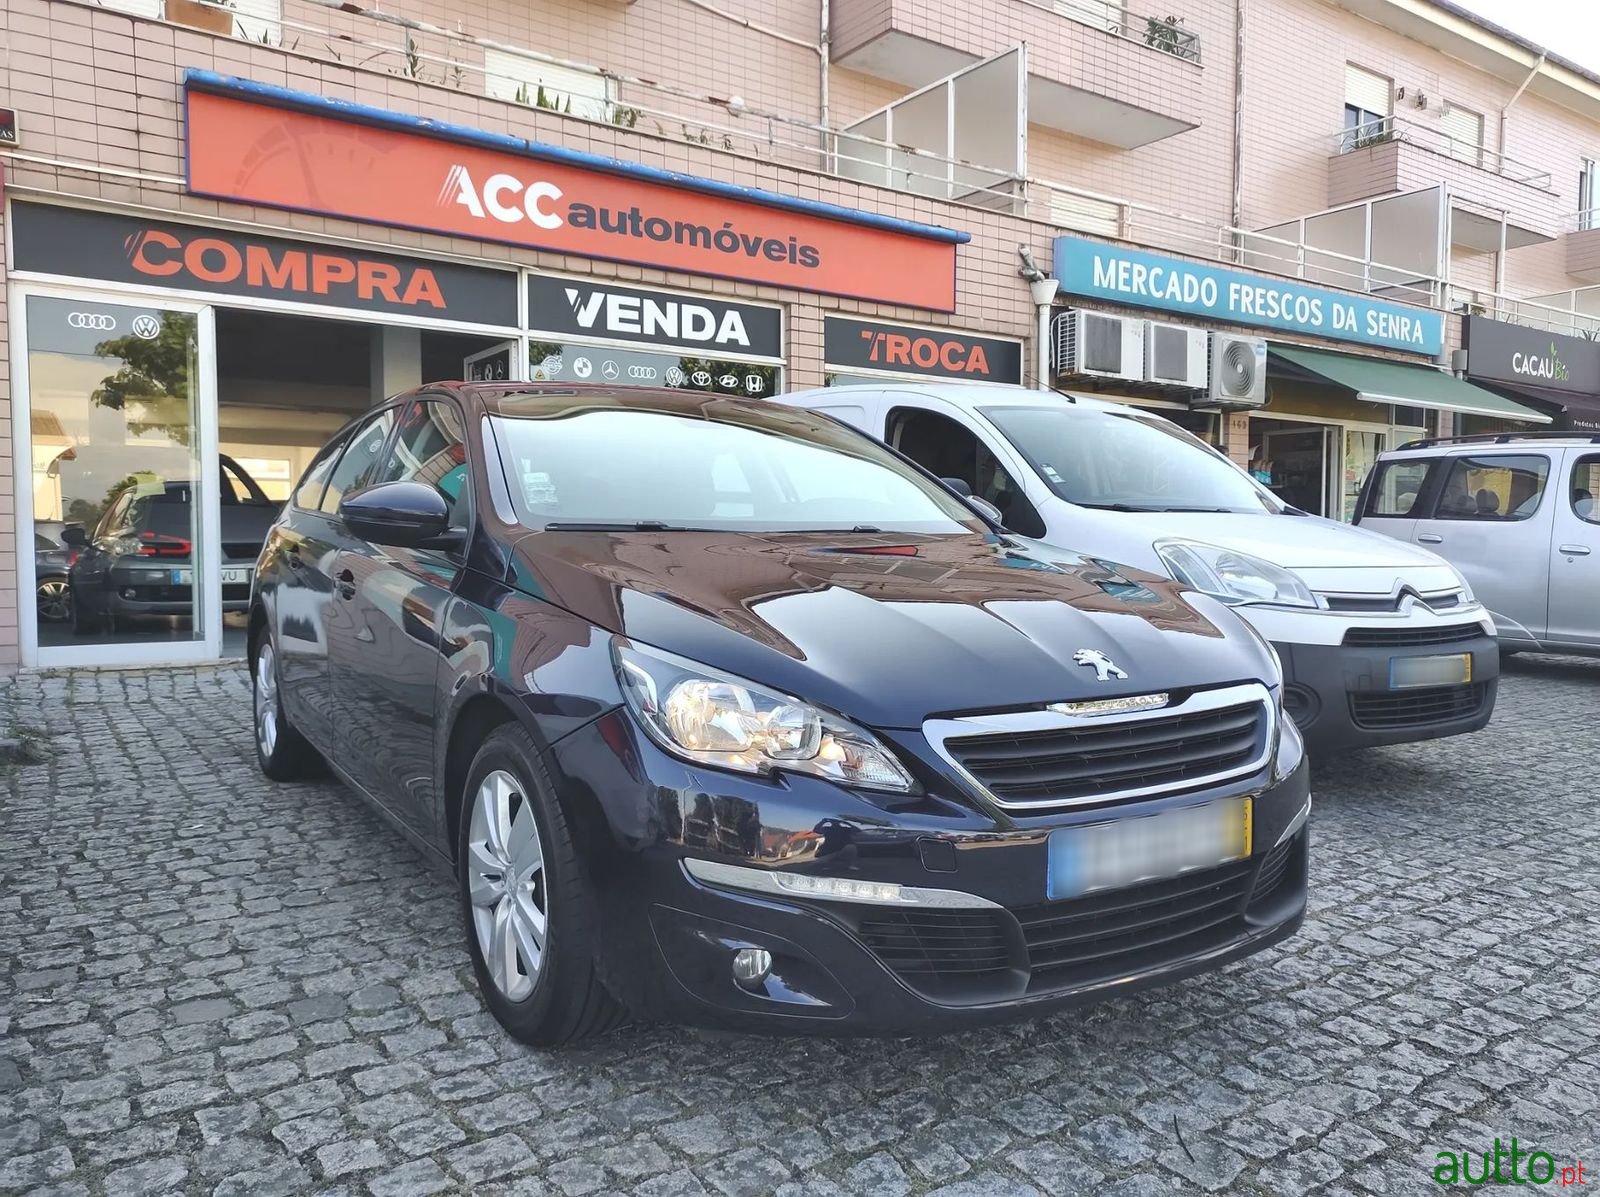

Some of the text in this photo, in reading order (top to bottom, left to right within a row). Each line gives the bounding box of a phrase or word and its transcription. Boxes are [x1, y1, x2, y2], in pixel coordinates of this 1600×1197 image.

[0, 127, 14, 138] AS
[437, 164, 821, 269] ACC automóveis
[124, 230, 447, 308] COMPRA
[565, 289, 751, 347] VENDA
[1093, 256, 1425, 345] MERCADO FRESCOS DA SENRA
[860, 329, 992, 375] TROCA
[1512, 352, 1553, 378] CACAU
